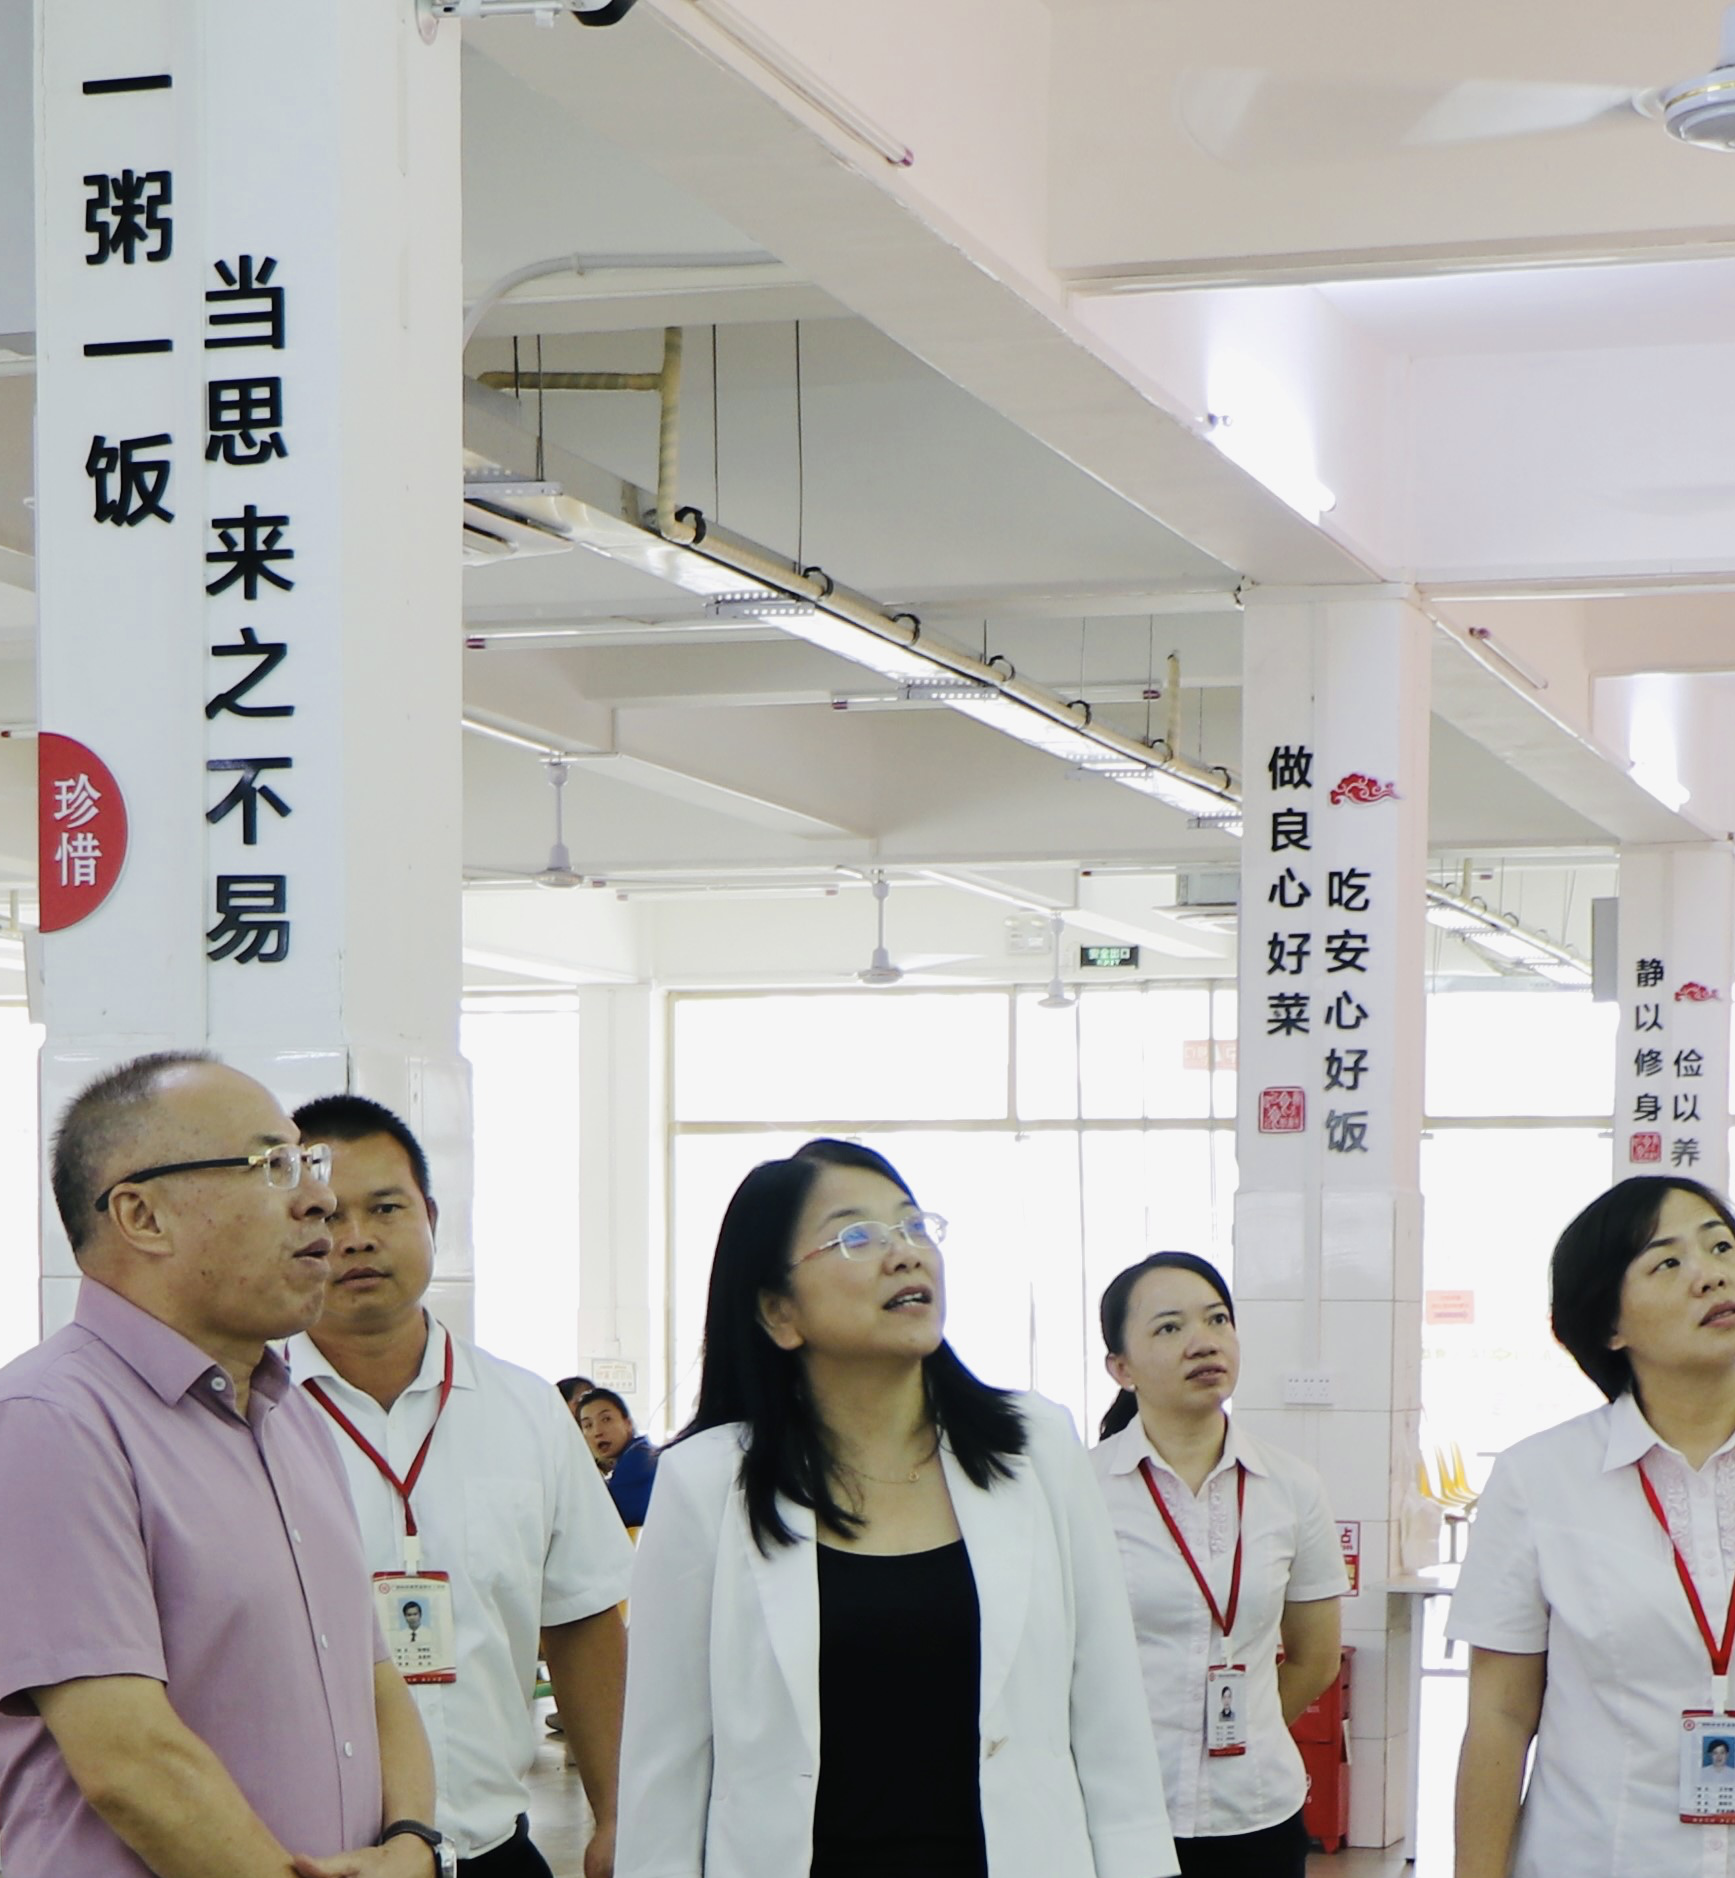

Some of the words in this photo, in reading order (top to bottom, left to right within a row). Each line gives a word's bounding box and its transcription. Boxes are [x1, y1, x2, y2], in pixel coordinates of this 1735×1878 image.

[82, 74, 175, 527] 一粥一饭
[204, 254, 295, 965] 当思来之不易
[54, 773, 103, 887] 珍惜
[1266, 745, 1314, 1037] 做良心好菜
[1089, 948, 1131, 959] 安全出口
[1323, 868, 1372, 1155] 吃安心好饭
[1633, 958, 1665, 1122] 静以修身
[1670, 1048, 1704, 1168] 俭以养
